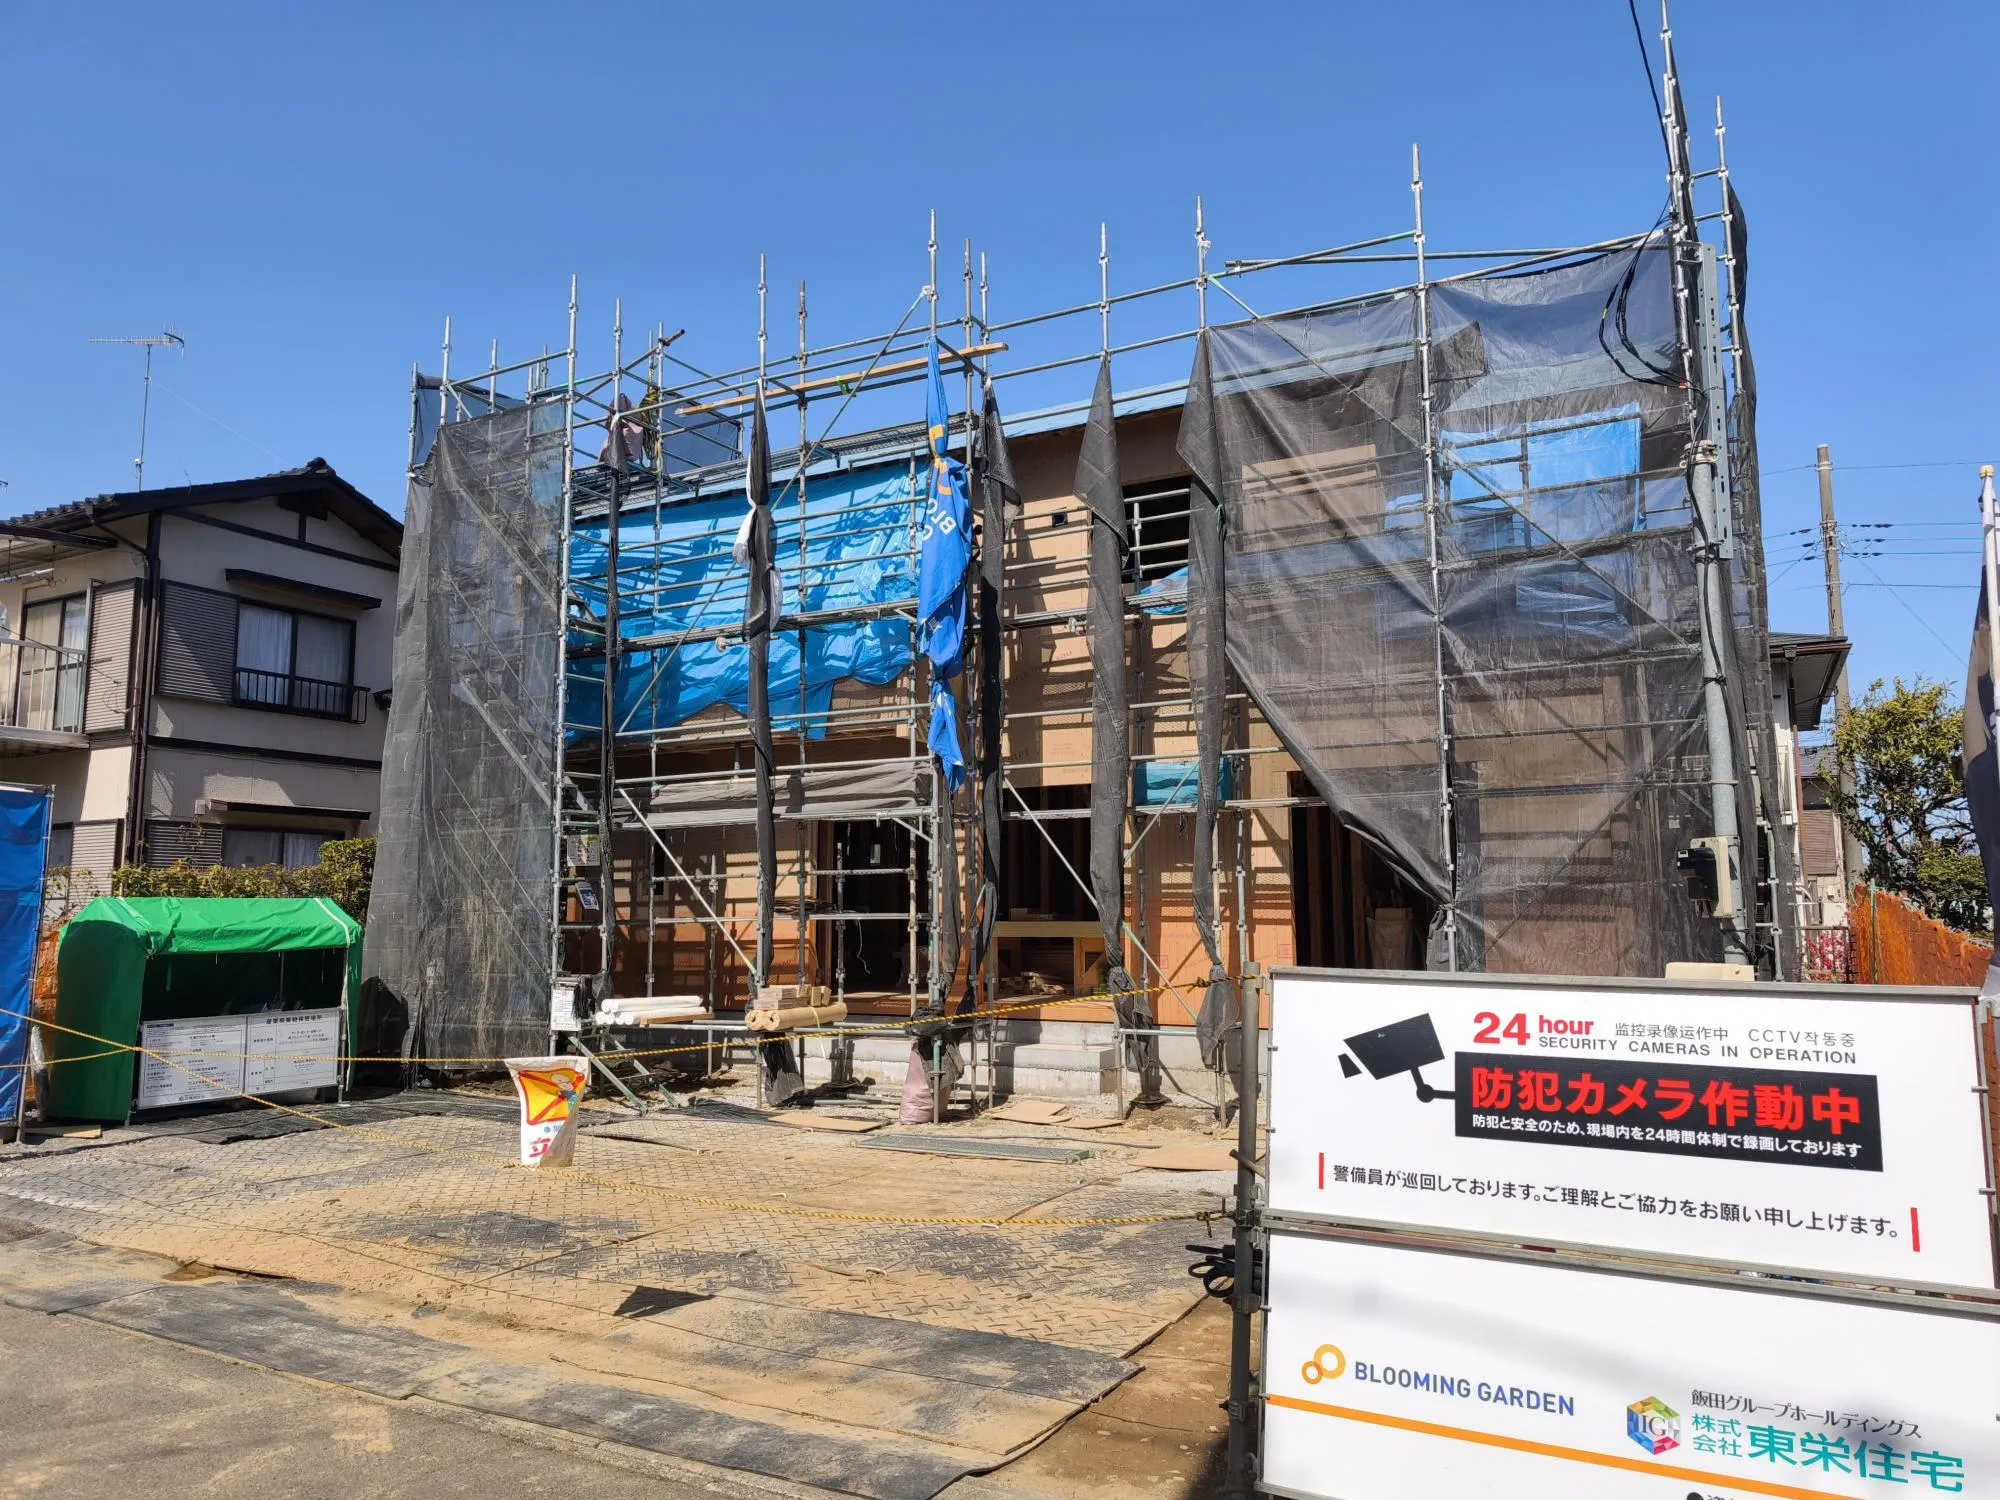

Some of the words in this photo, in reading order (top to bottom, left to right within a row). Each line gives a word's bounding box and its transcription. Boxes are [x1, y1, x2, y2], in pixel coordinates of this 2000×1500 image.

[1474, 1011, 1531, 1046] 24
[1539, 1015, 1594, 1035] hour
[1615, 1022, 1728, 1041] 监控录像运作中
[1748, 1028, 1856, 1048] CCTV작동중
[1538, 1036, 1618, 1051] SECURITY
[1628, 1040, 1711, 1056] CAMERAS
[1721, 1045, 1738, 1058] IN
[1749, 1046, 1857, 1064] OPERATION
[1471, 1066, 1861, 1135] 防犯カメラ作動中
[1472, 1113, 1862, 1158] 防犯と安全のため、現場内を24時間体制で録画しております
[1333, 1164, 1898, 1238] 警備員が巡回しております。ご理解とご協力をお願い申し上げます。
[1355, 1361, 1471, 1398] BLOOMING
[1477, 1382, 1575, 1417] GARDEN
[1692, 1389, 1923, 1439] 飯田グループホールディングス
[1692, 1413, 1742, 1438] 株式
[1693, 1434, 1743, 1458] 会社
[1746, 1425, 1965, 1493] 東栄住宅
